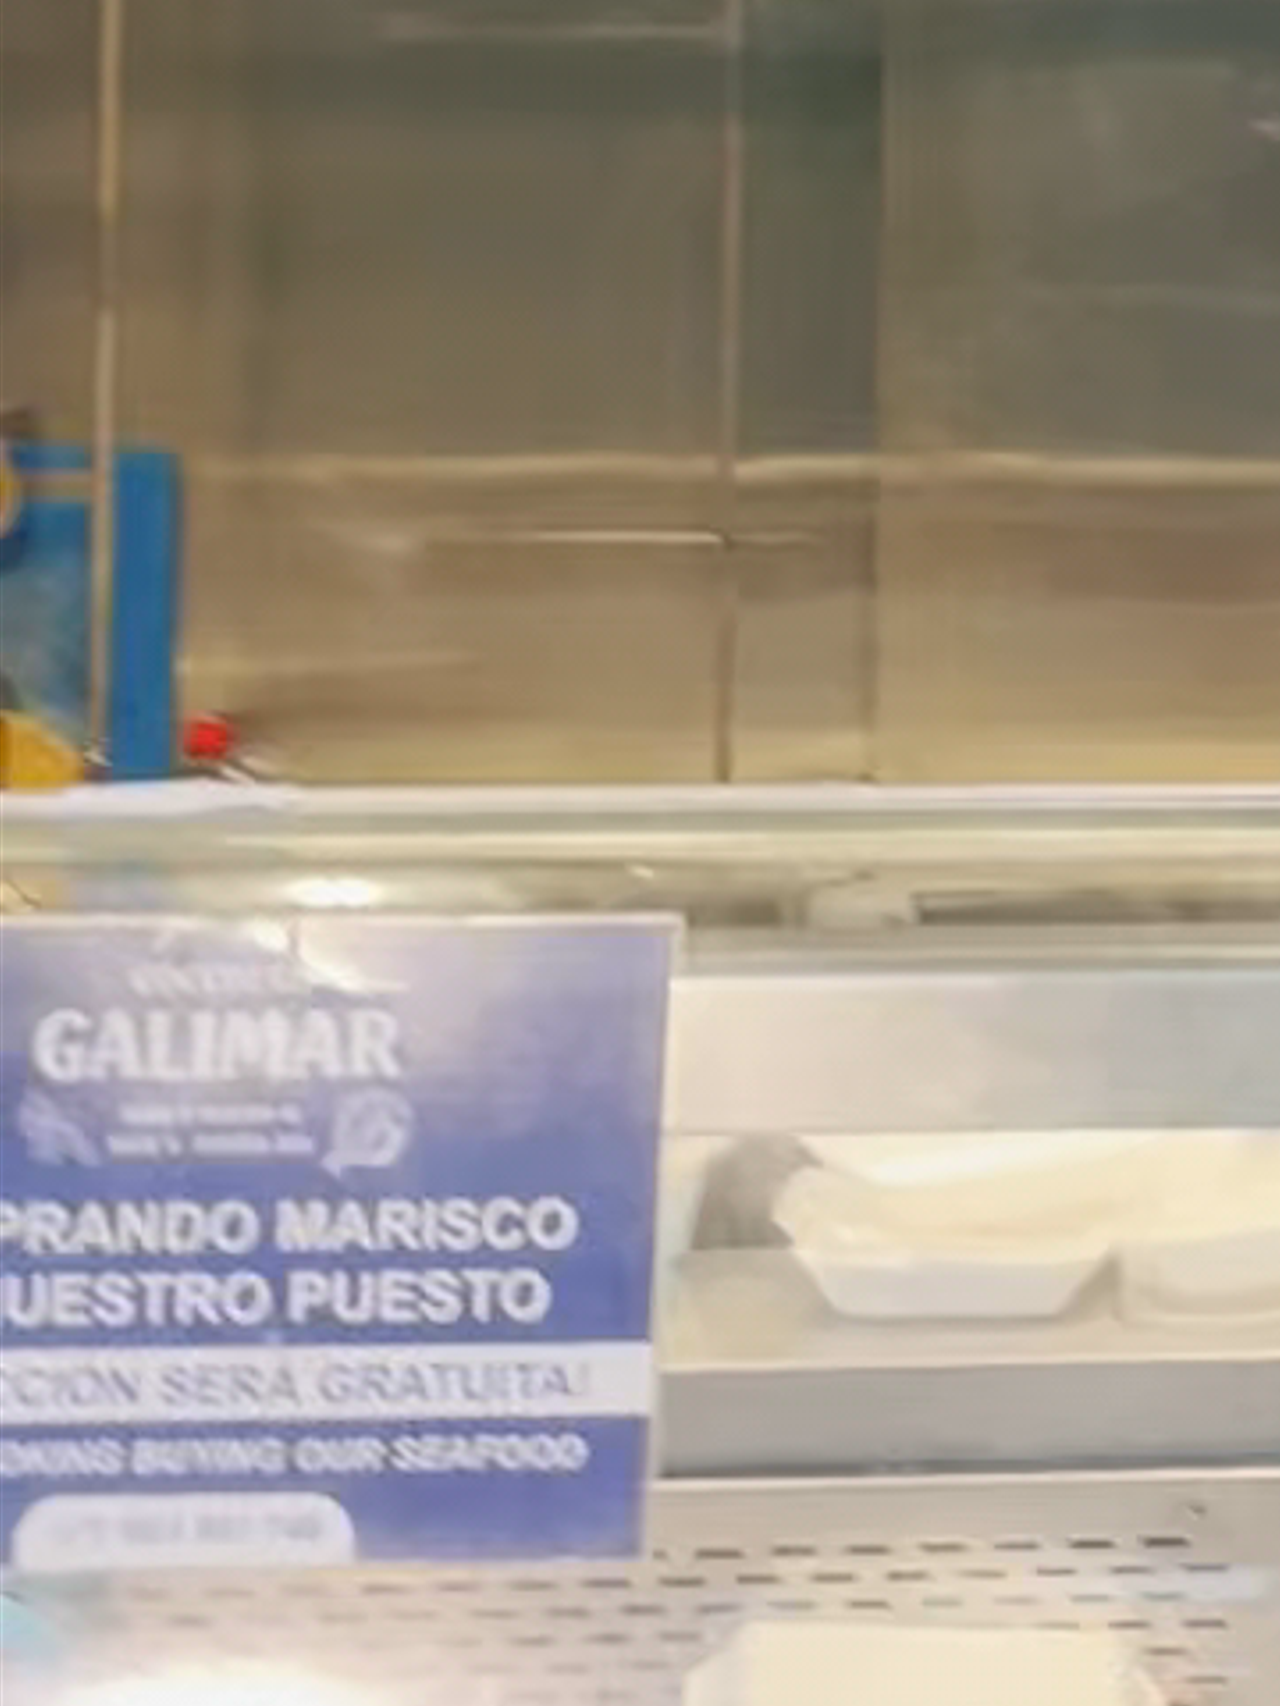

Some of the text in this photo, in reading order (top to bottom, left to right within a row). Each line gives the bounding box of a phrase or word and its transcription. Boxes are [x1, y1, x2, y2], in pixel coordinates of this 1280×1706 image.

[32, 1007, 404, 1084] GALIMAR
[275, 1195, 579, 1253] MARISCO
[286, 1266, 553, 1325] PUESTO
